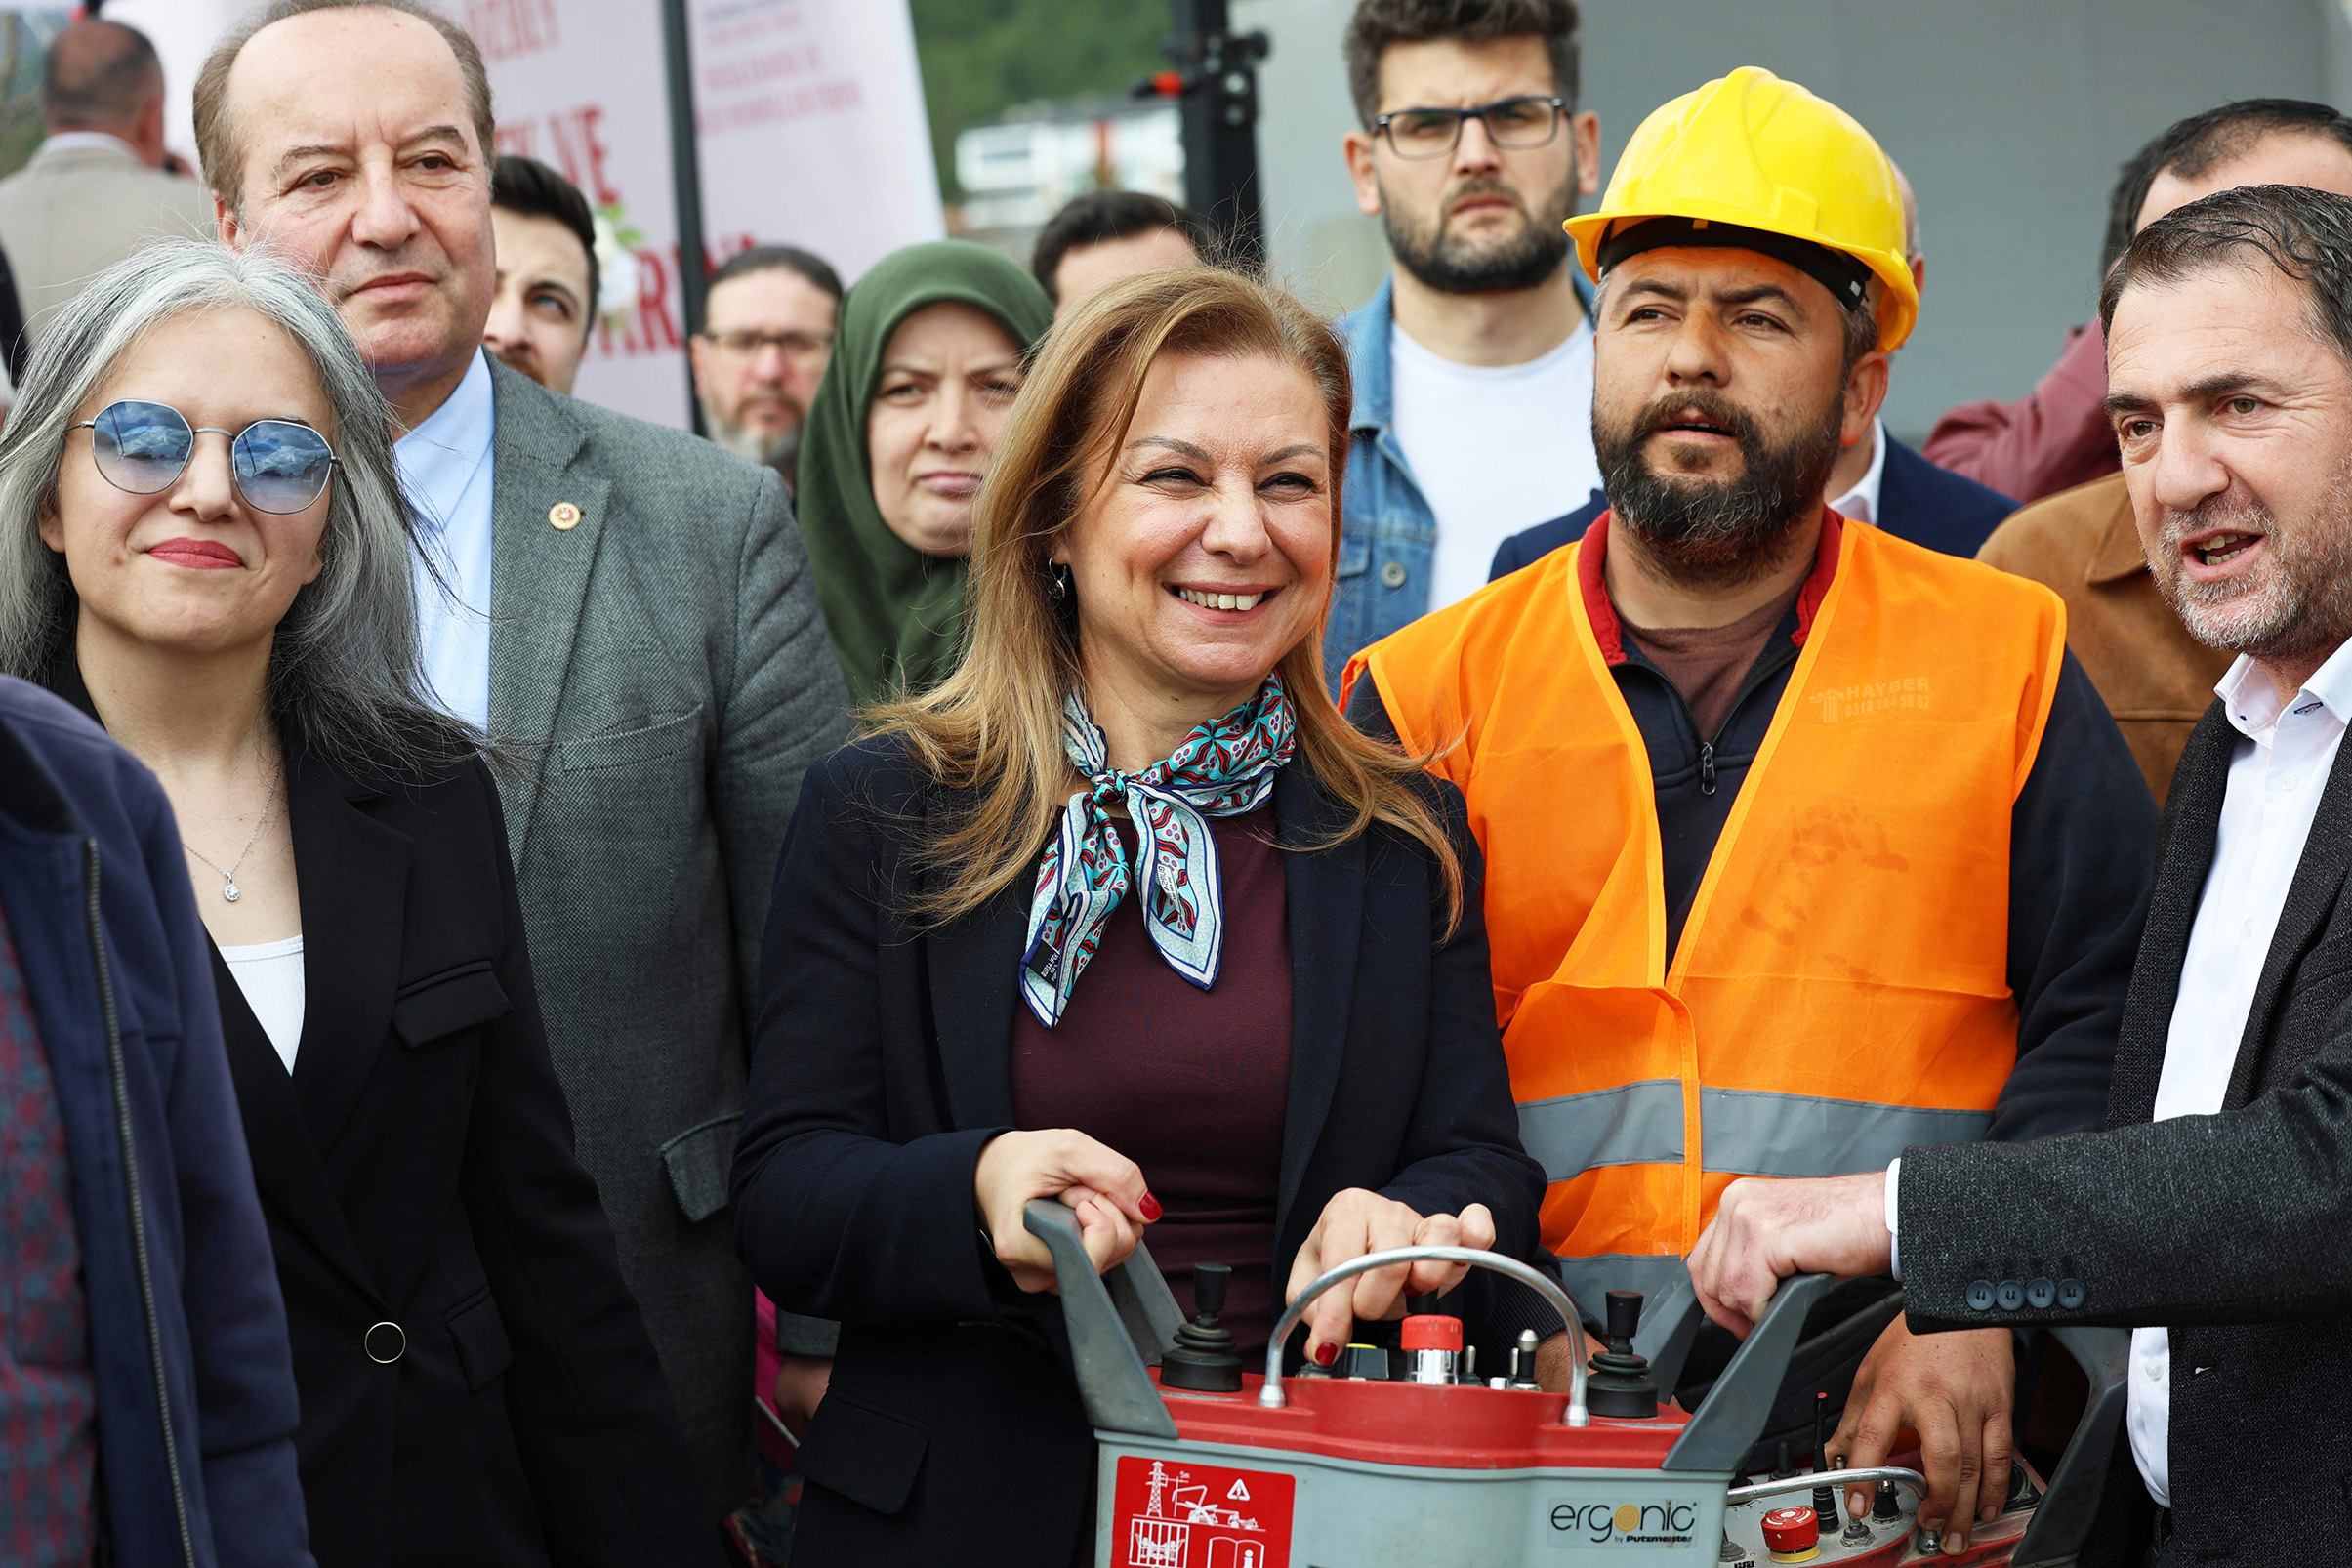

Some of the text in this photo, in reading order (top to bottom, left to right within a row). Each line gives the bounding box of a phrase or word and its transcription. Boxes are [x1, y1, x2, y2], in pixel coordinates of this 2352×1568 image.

[1846, 677, 1929, 701] HAYBER
[1845, 700, 1874, 717] 0312
[1550, 1504, 1695, 1543] ergonic
[1614, 1535, 1624, 1544] by
